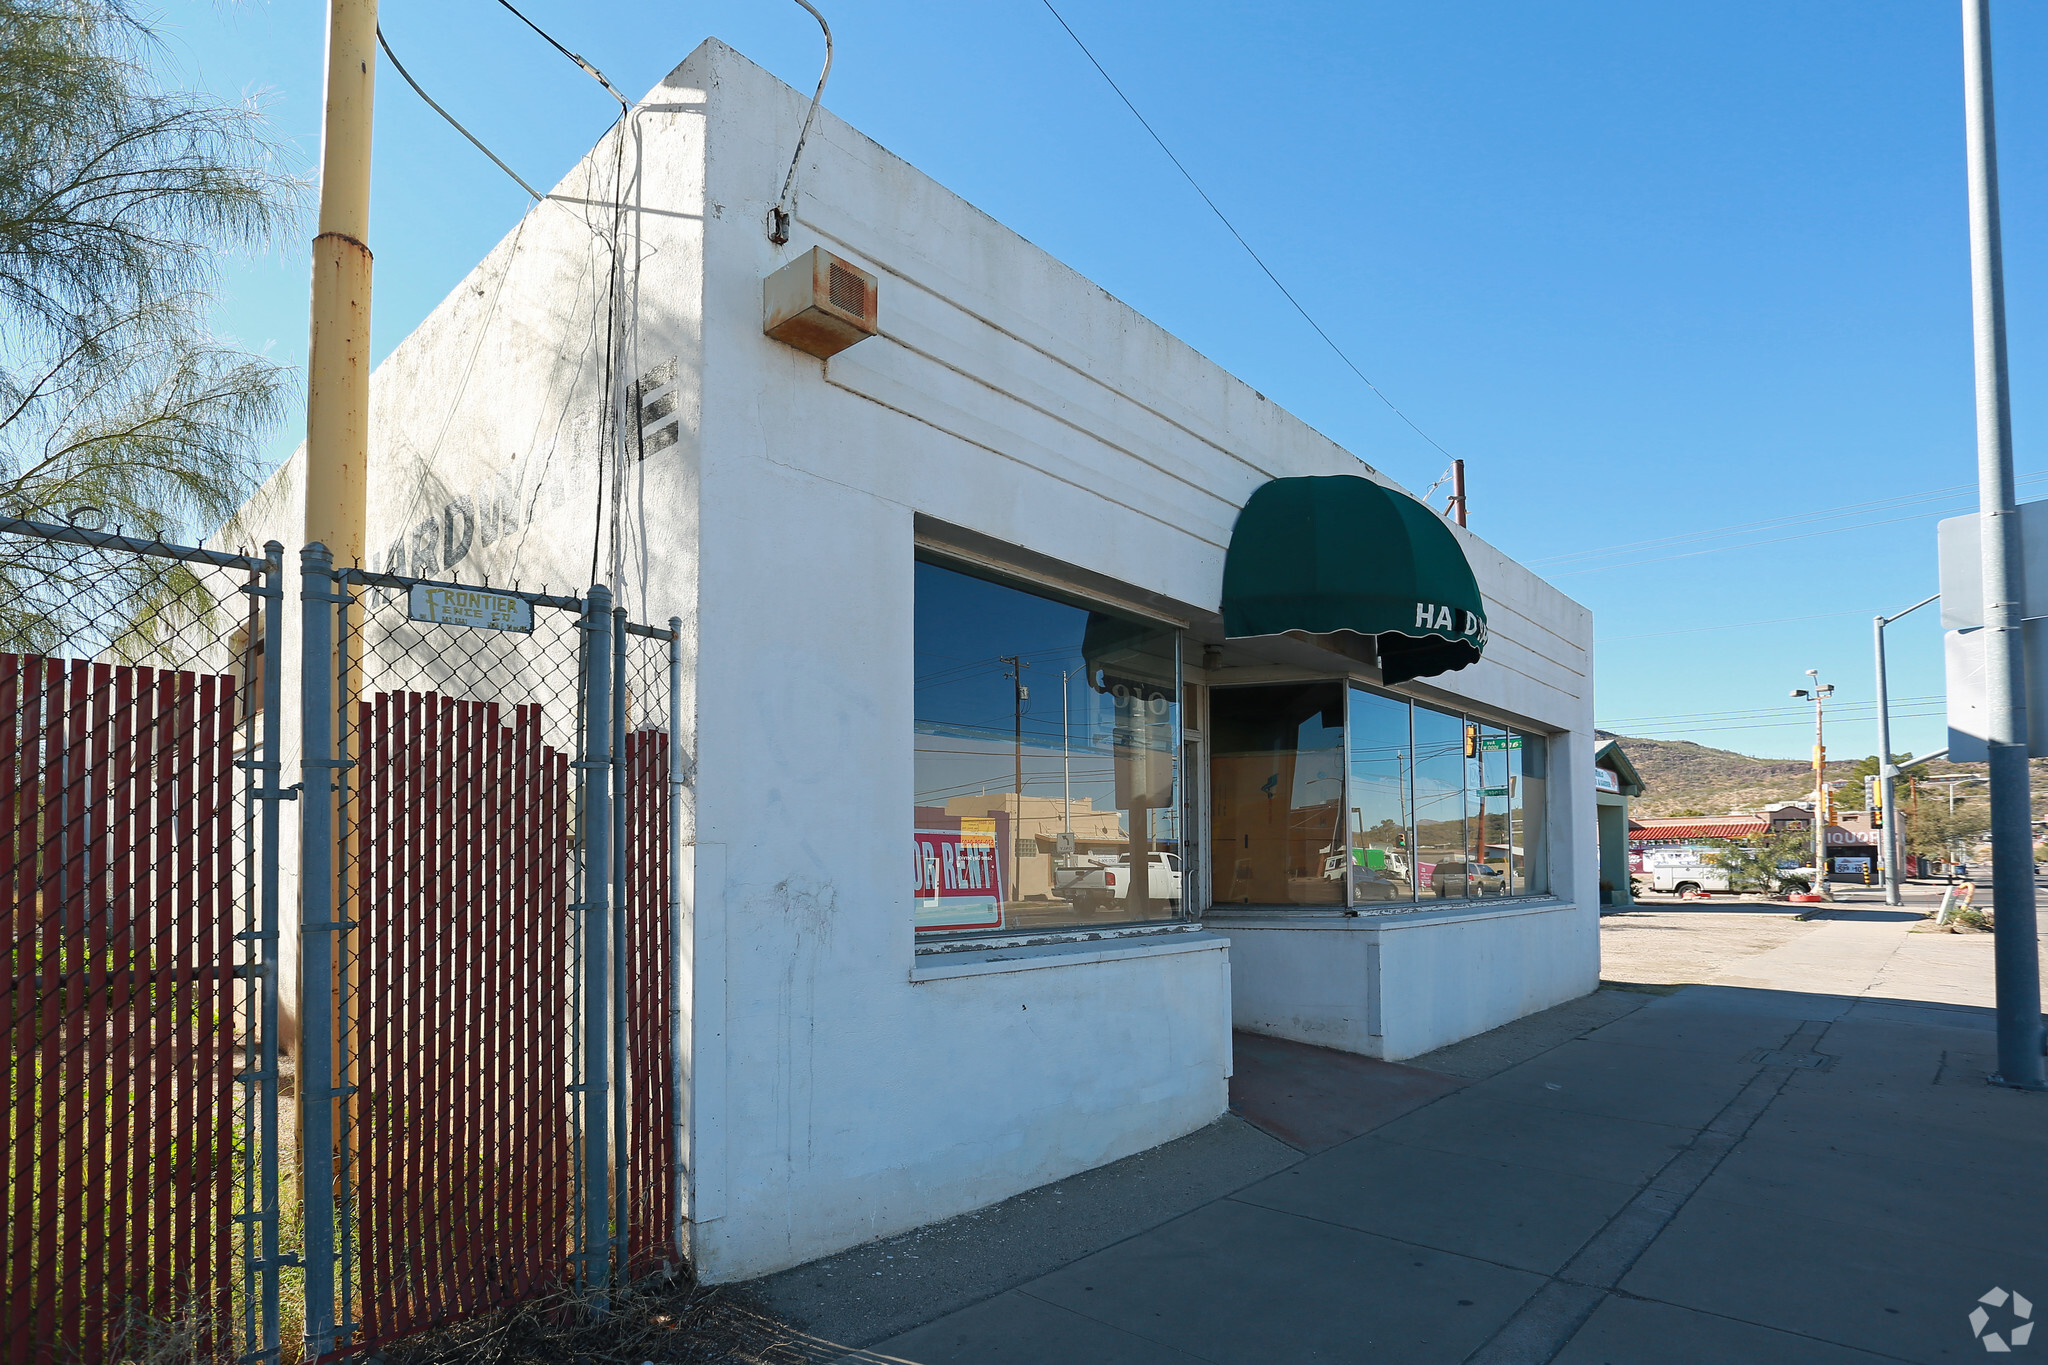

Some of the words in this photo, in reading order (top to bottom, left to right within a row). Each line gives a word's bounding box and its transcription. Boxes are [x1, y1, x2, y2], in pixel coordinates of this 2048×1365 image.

[425, 588, 518, 620] FRONTIER
[1112, 684, 1167, 715] 910
[942, 841, 991, 890] RENT
